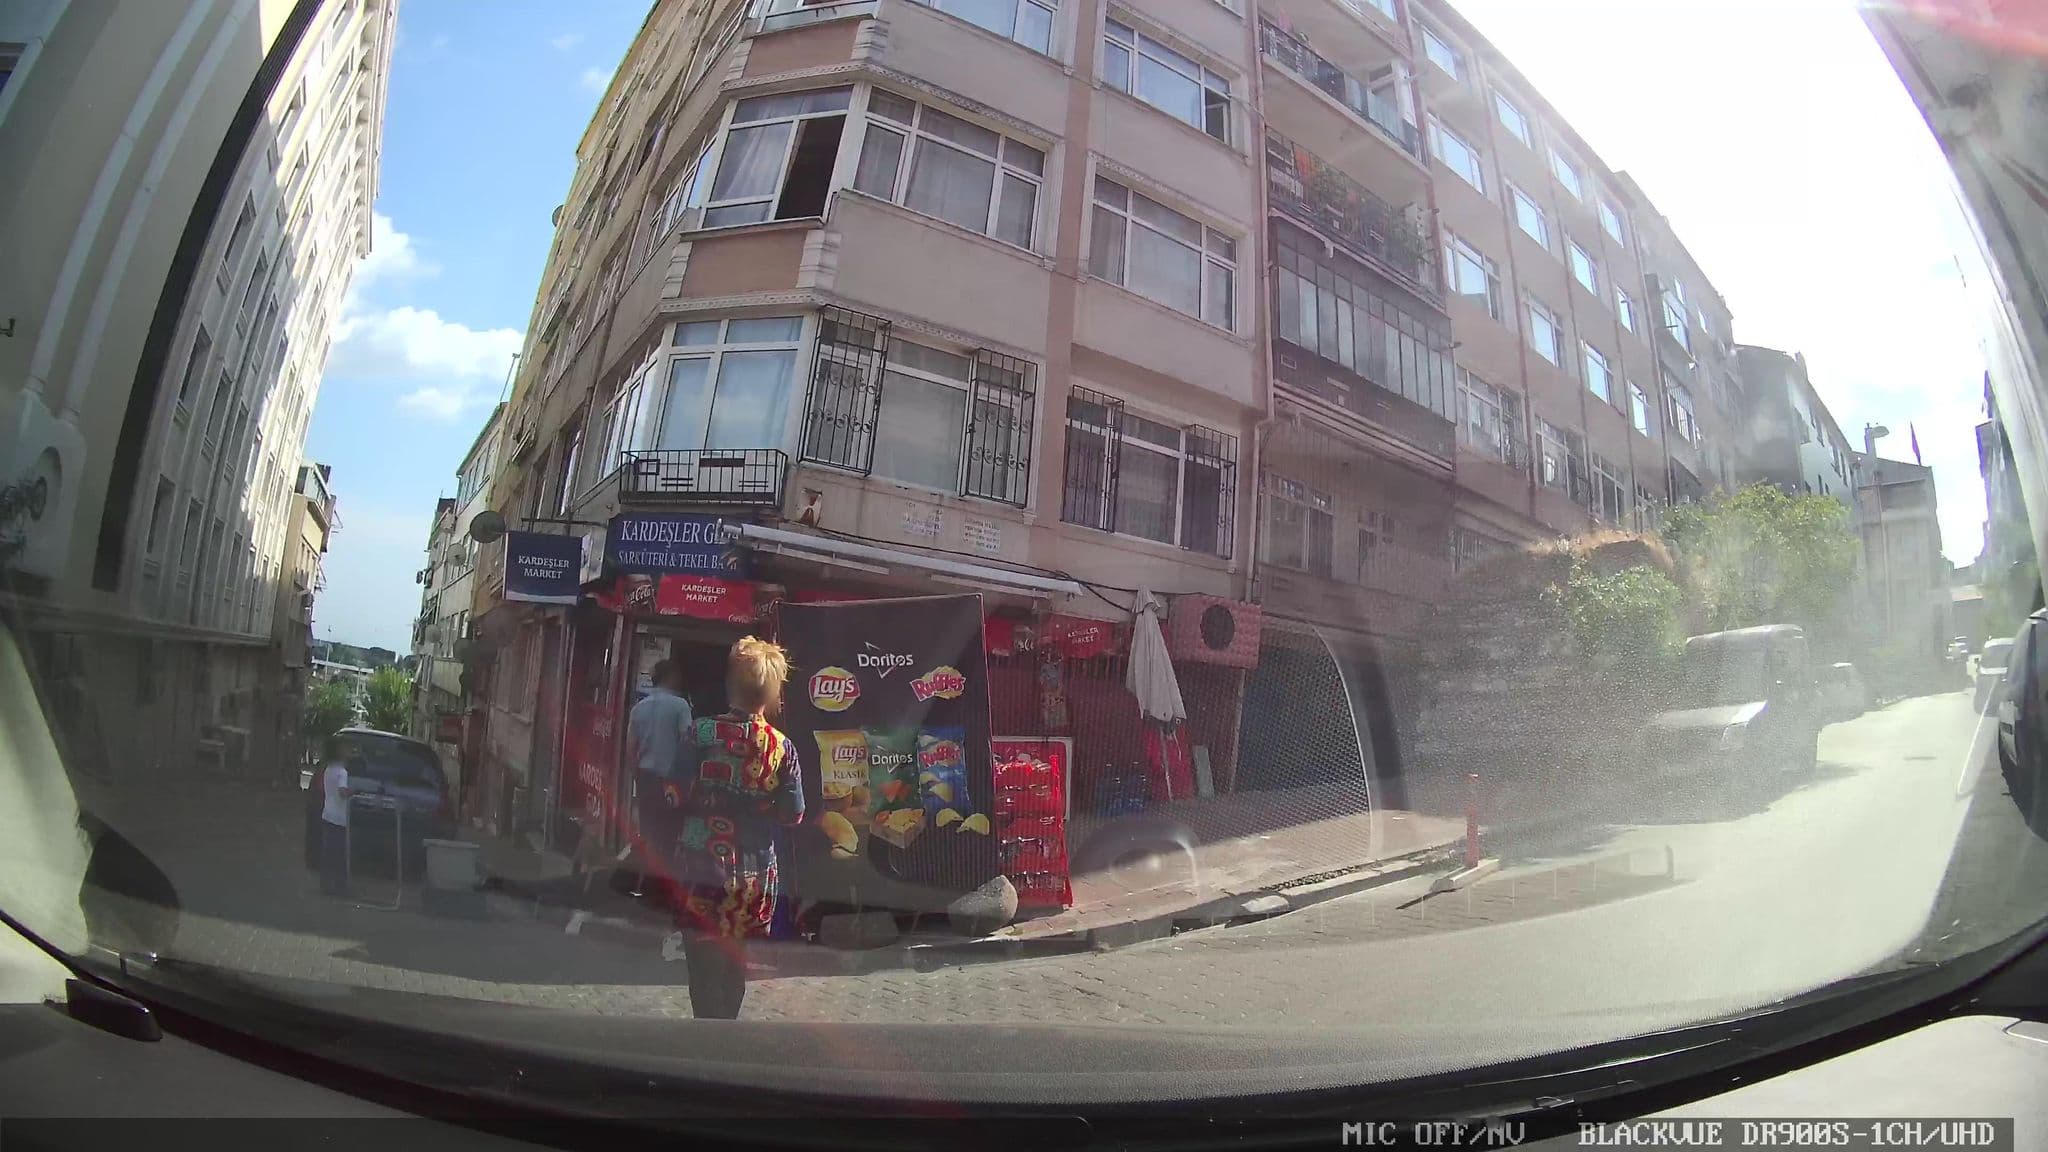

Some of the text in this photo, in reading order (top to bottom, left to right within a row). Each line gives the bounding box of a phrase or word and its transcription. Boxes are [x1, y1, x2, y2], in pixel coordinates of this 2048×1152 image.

[621, 520, 700, 547] KARDEŞLER
[518, 555, 570, 568] KARDEŞLER
[669, 552, 677, 567] &
[679, 551, 709, 569] TEKEL
[524, 568, 562, 579] MARKET
[682, 584, 726, 596] KARDEŞLER
[686, 593, 718, 603] MARKET
[857, 654, 914, 667] Doritos
[872, 753, 913, 765] Doritos
